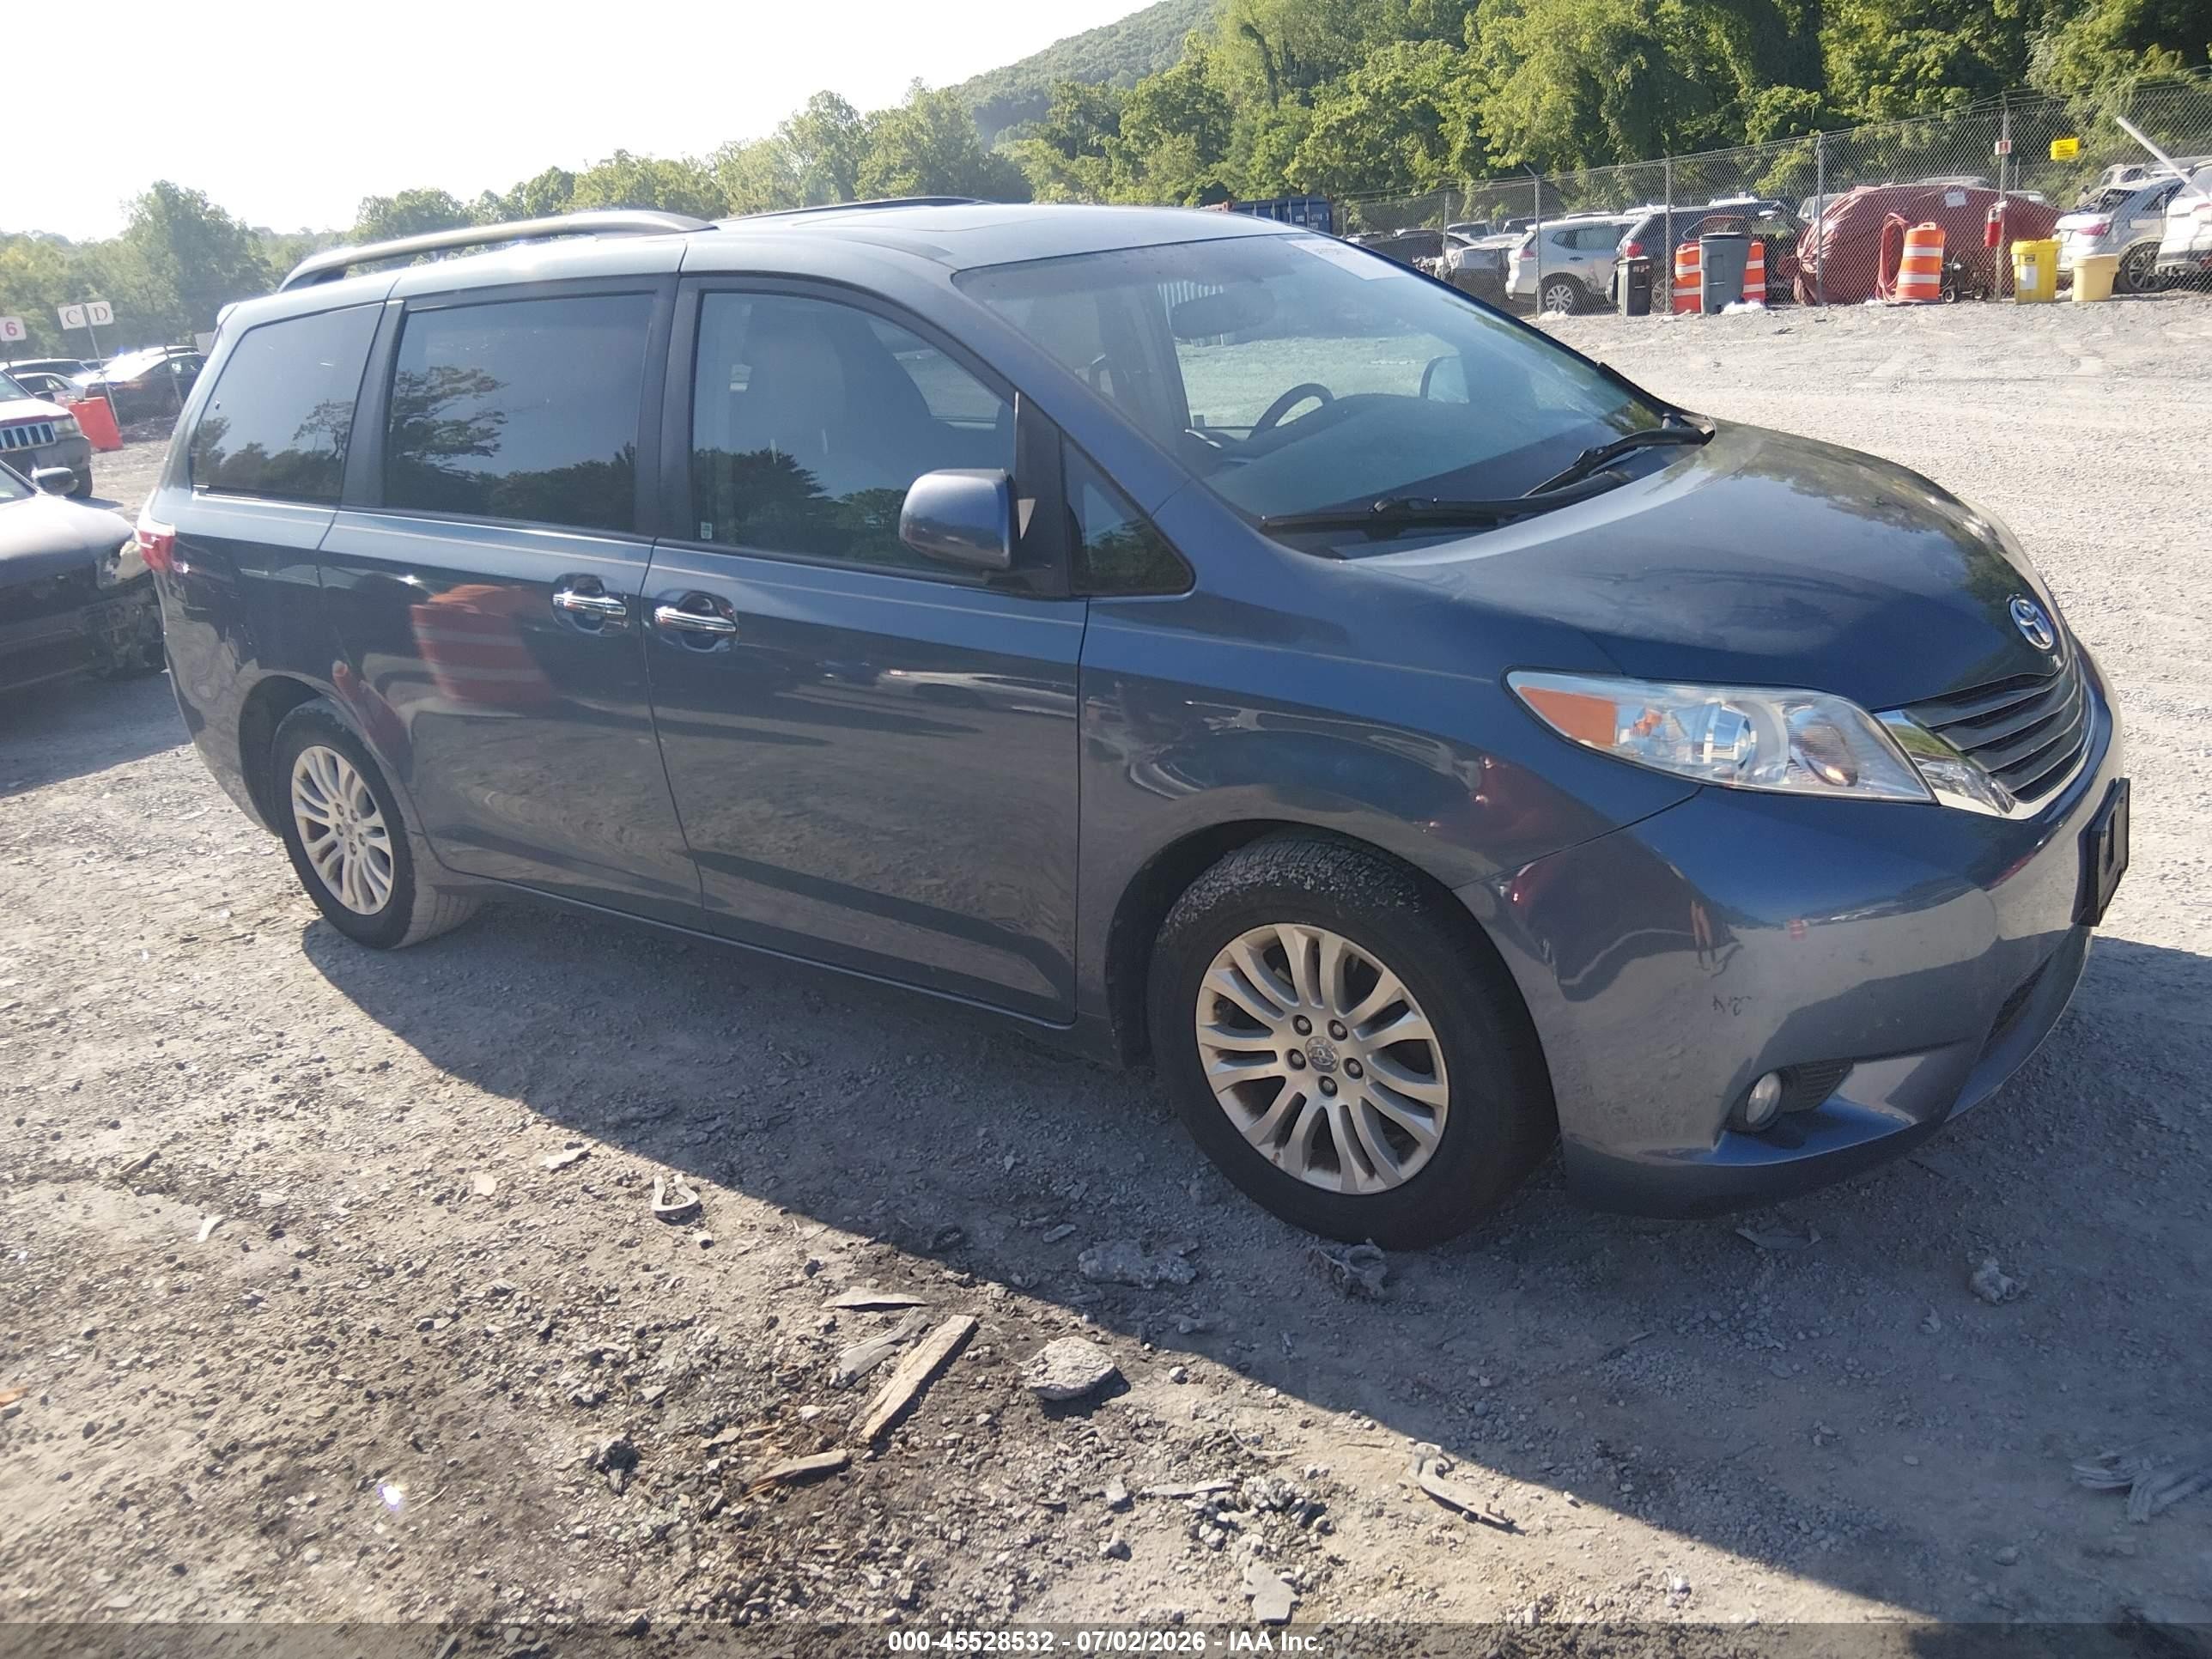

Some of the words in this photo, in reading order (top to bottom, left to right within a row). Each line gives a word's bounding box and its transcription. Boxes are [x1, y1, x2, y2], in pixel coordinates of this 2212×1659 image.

[65, 309, 78, 325] C
[94, 307, 108, 321] D
[5, 321, 17, 337] 6
